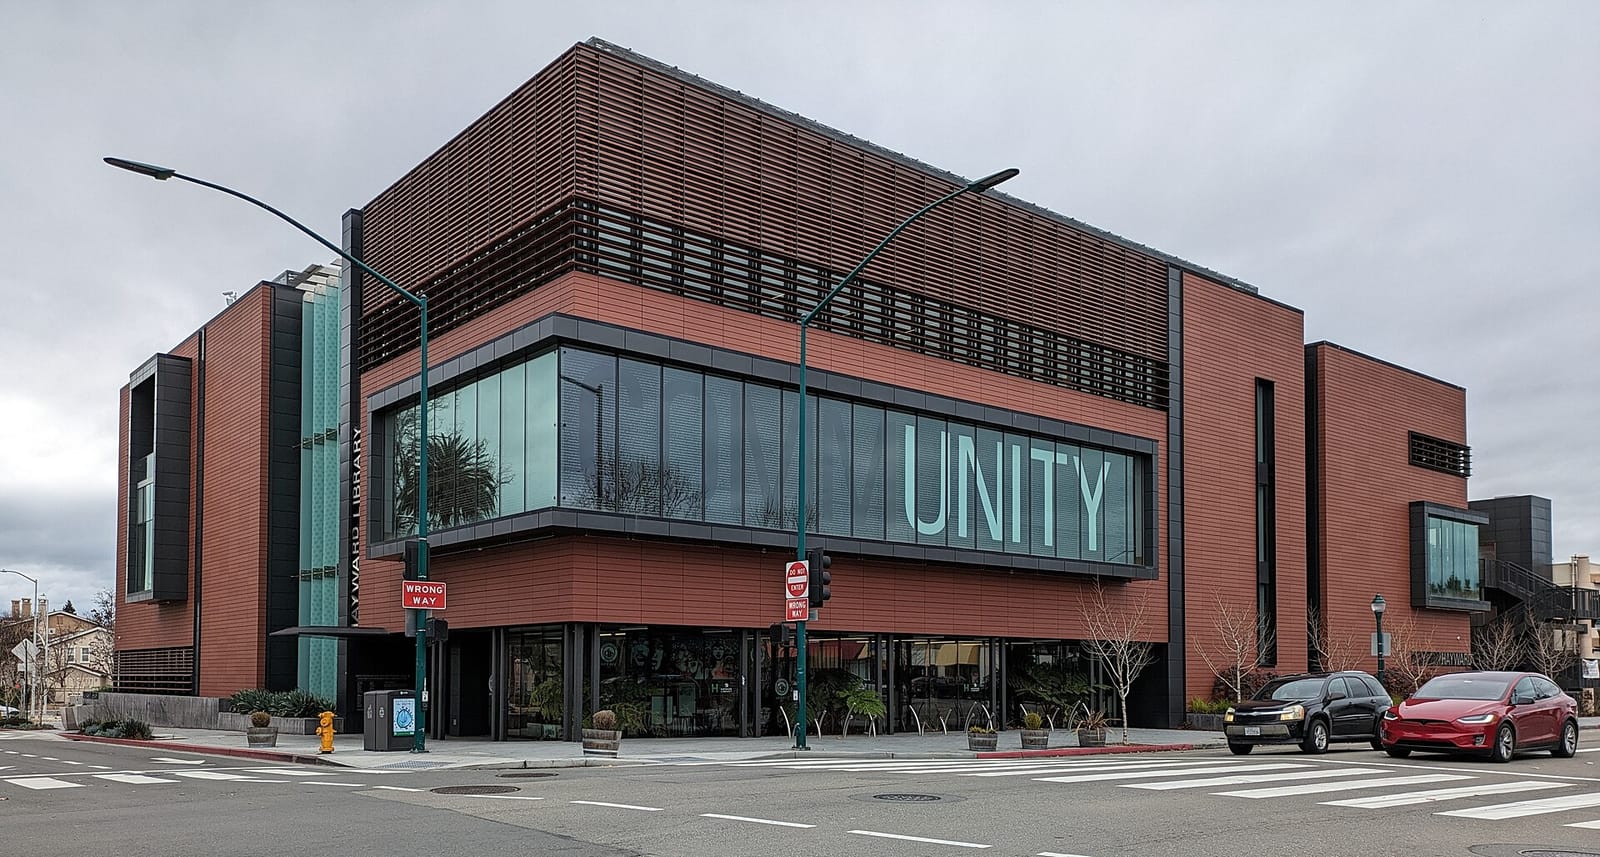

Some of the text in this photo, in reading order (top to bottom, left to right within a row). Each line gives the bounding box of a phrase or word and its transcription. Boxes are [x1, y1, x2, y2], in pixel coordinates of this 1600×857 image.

[352, 428, 362, 518] LIBRARY
[406, 585, 443, 594] WRONG
[412, 596, 436, 605] WAY
[789, 601, 806, 609] WRONG
